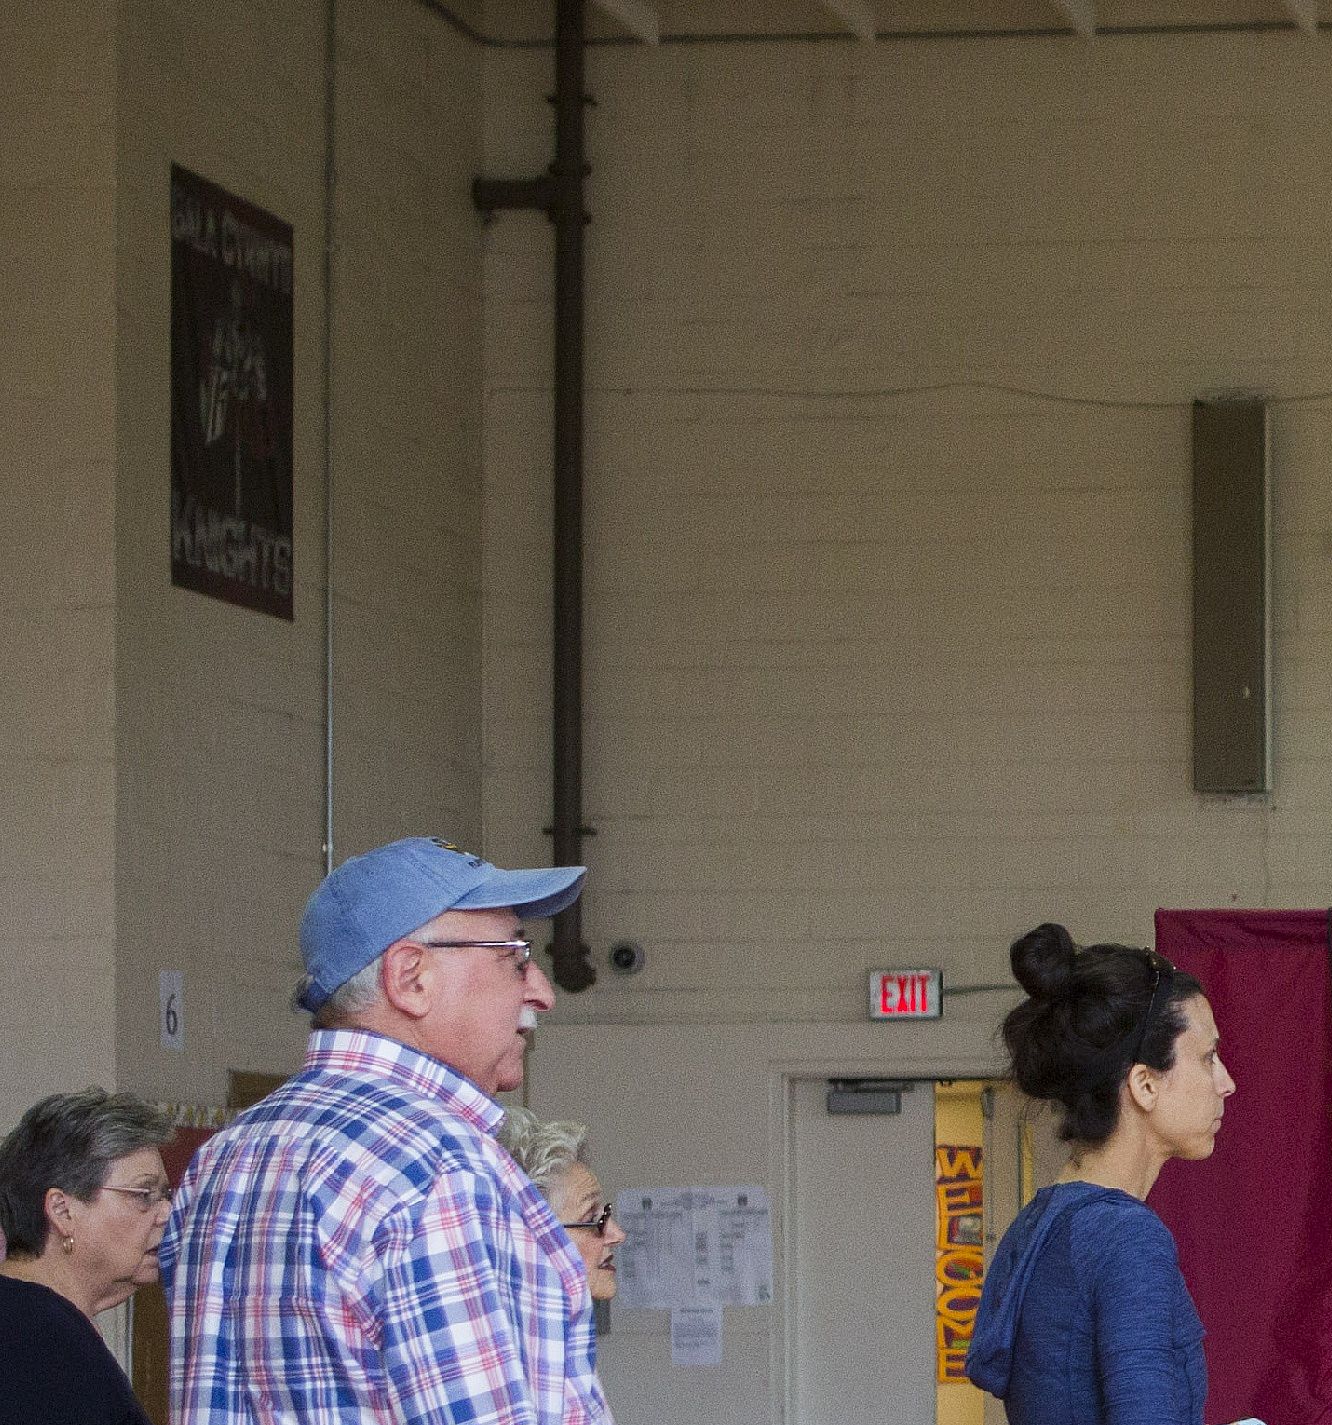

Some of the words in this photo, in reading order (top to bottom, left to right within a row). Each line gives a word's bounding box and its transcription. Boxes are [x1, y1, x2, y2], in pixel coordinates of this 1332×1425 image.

[174, 492, 292, 595] KNIGHTS
[880, 974, 930, 1013] EXIT
[165, 994, 178, 1035] 6
